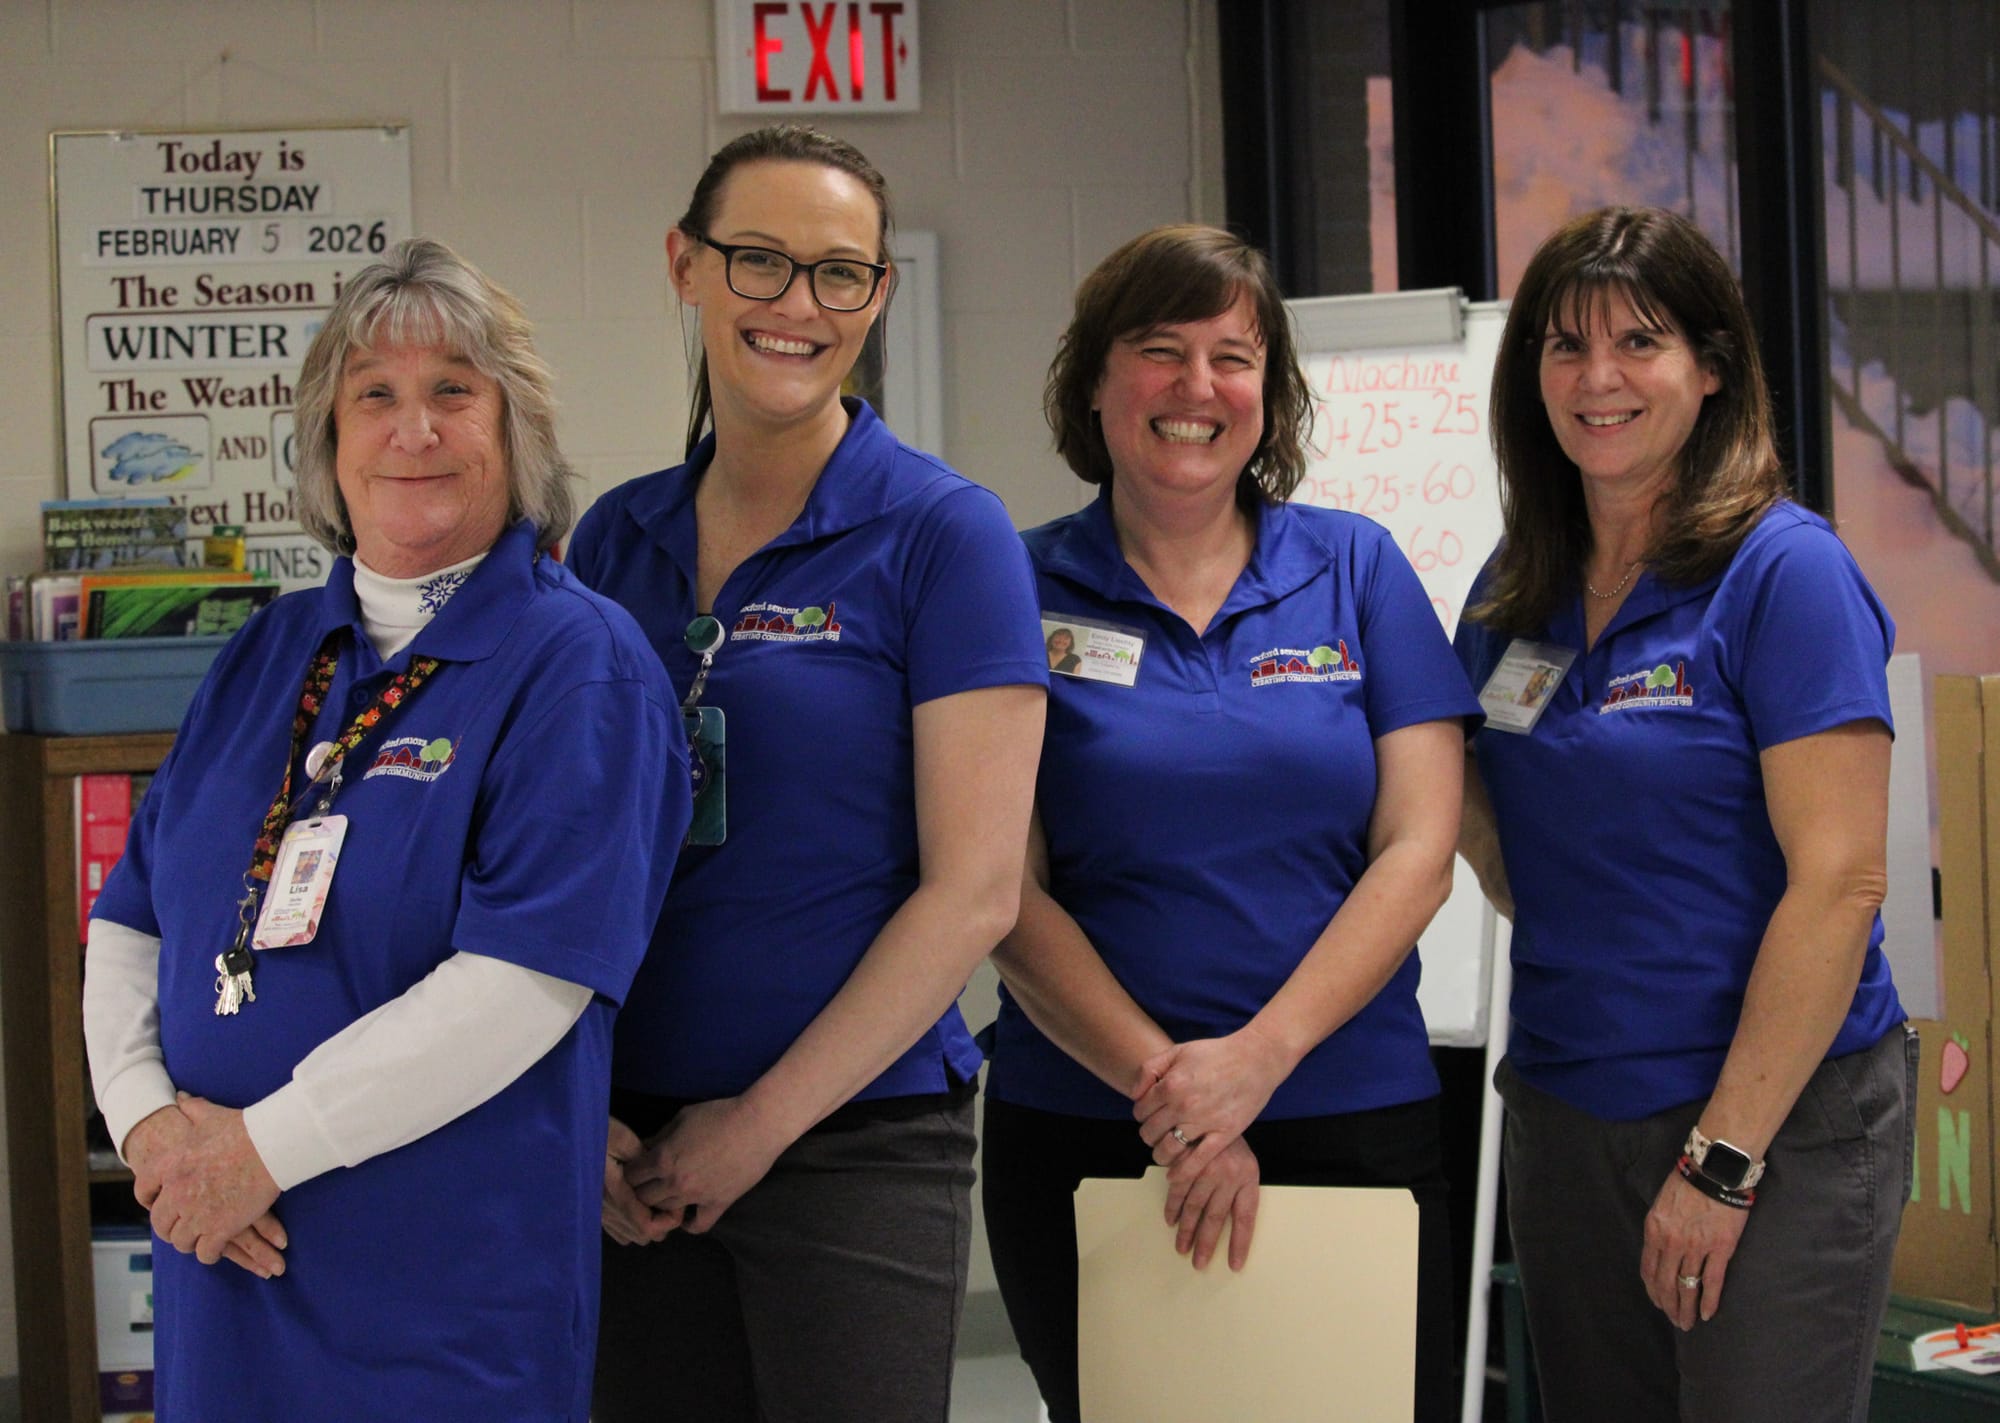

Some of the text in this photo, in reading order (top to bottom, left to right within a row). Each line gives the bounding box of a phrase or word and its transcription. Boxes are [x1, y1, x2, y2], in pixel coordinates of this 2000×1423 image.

[754, 3, 904, 102] EXIT
[157, 140, 304, 180] Today is
[142, 185, 320, 213] THURSDAY
[98, 221, 386, 257] FEBRUARY 5 2026
[111, 275, 177, 308] The
[195, 274, 314, 307] Season
[102, 324, 288, 361] WINTER
[100, 374, 296, 412] The Weath
[216, 437, 267, 462] AND
[242, 490, 294, 524] Hol
